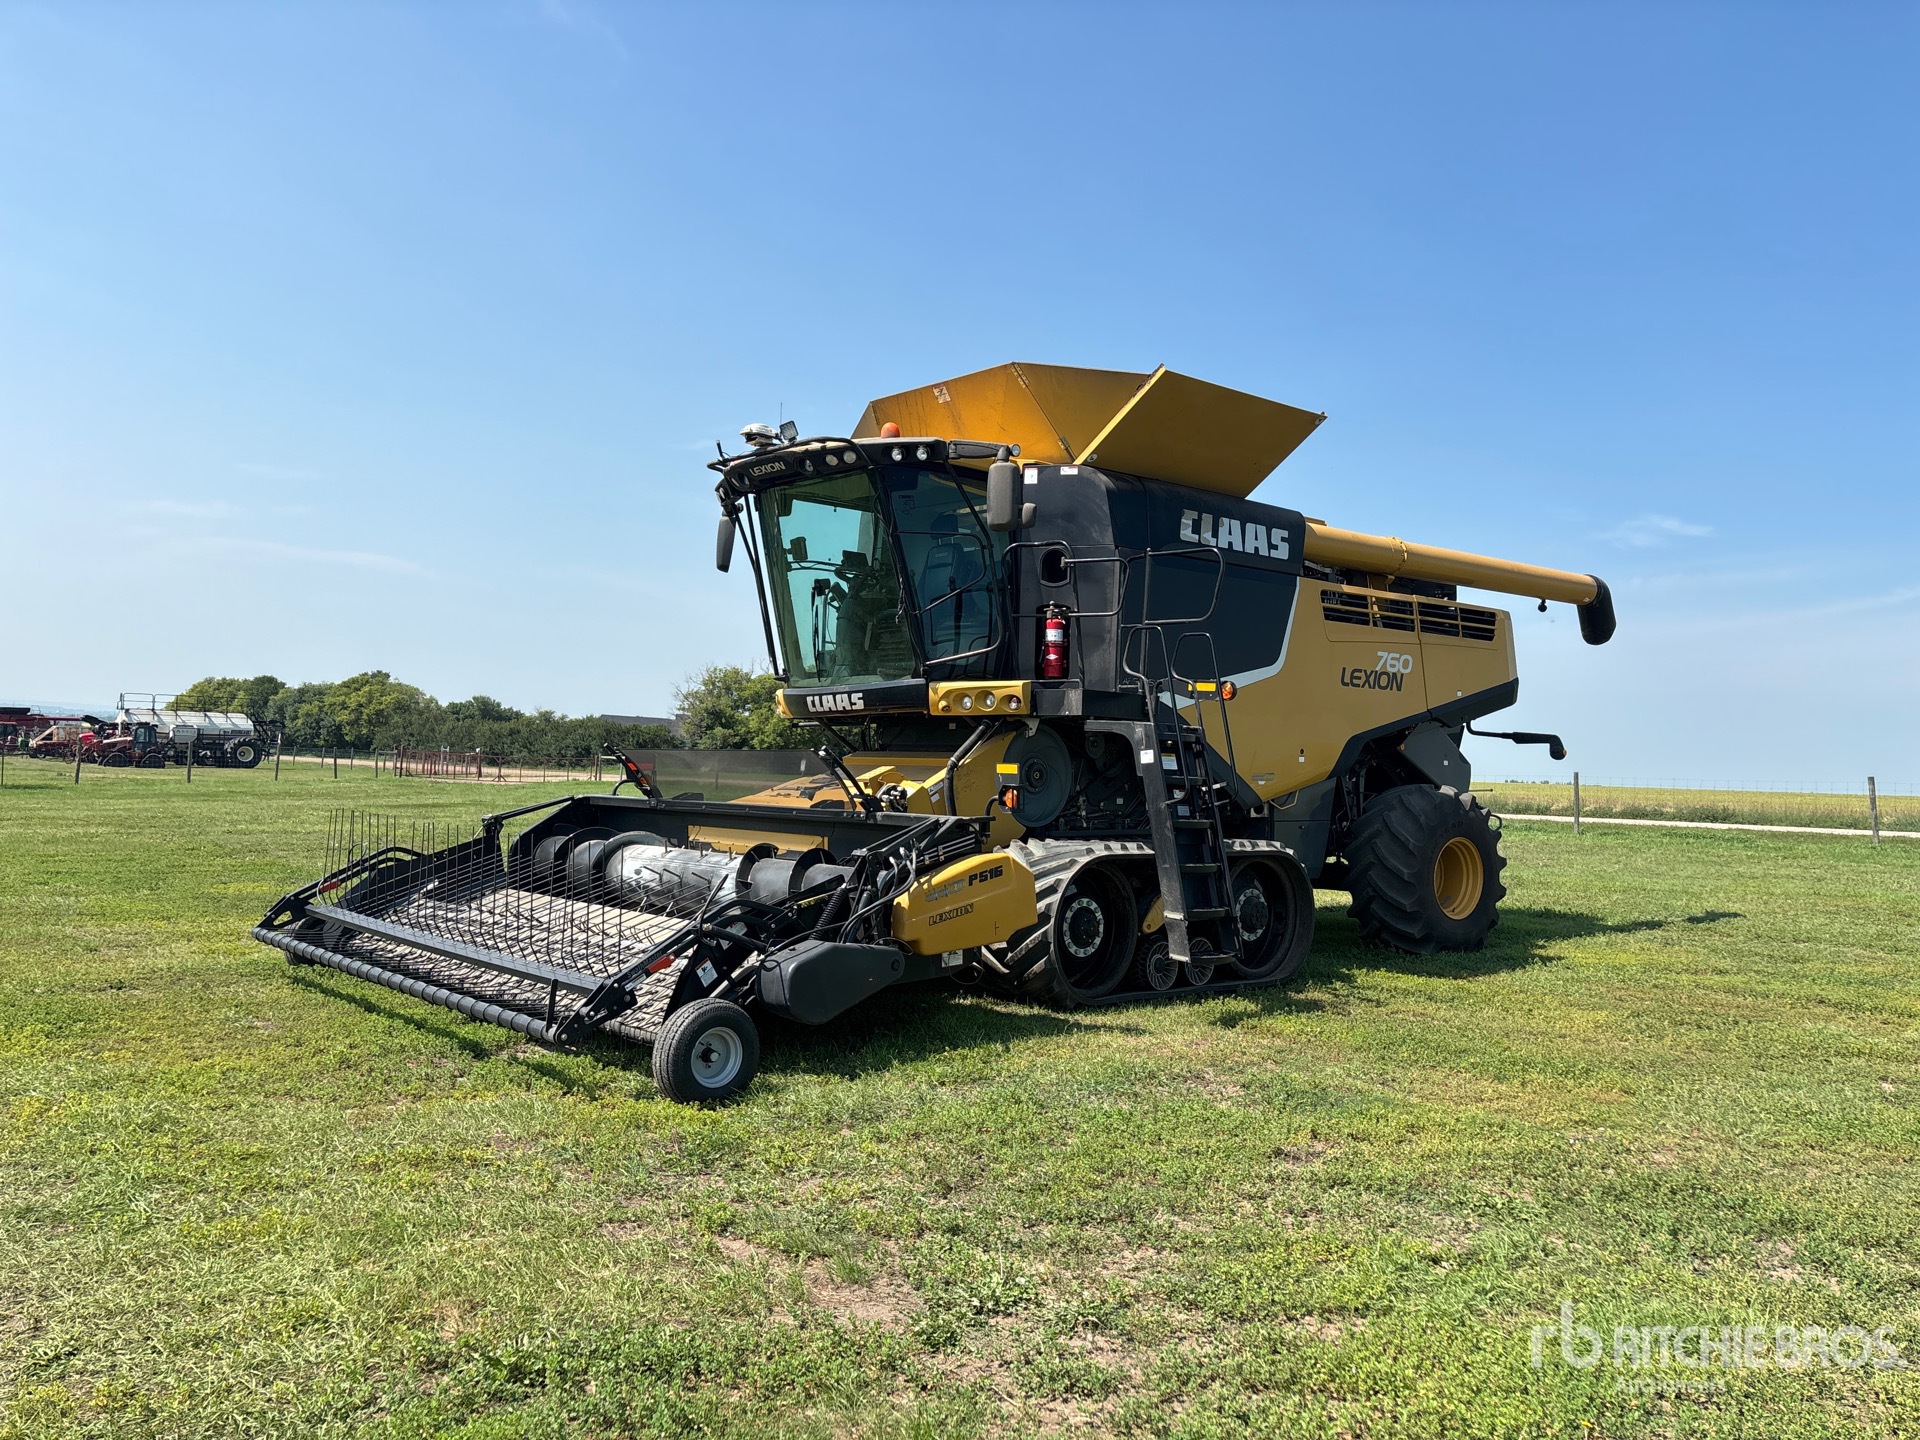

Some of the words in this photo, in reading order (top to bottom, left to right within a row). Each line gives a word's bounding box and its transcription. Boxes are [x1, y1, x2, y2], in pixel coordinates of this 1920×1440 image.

[749, 461, 786, 477] LEXION
[1180, 508, 1290, 560] CLAAS
[1375, 651, 1413, 674] 760
[1340, 666, 1404, 692] LEXION
[806, 692, 865, 713] CLAAS
[968, 864, 1004, 887] P516
[928, 902, 974, 926] LEXION
